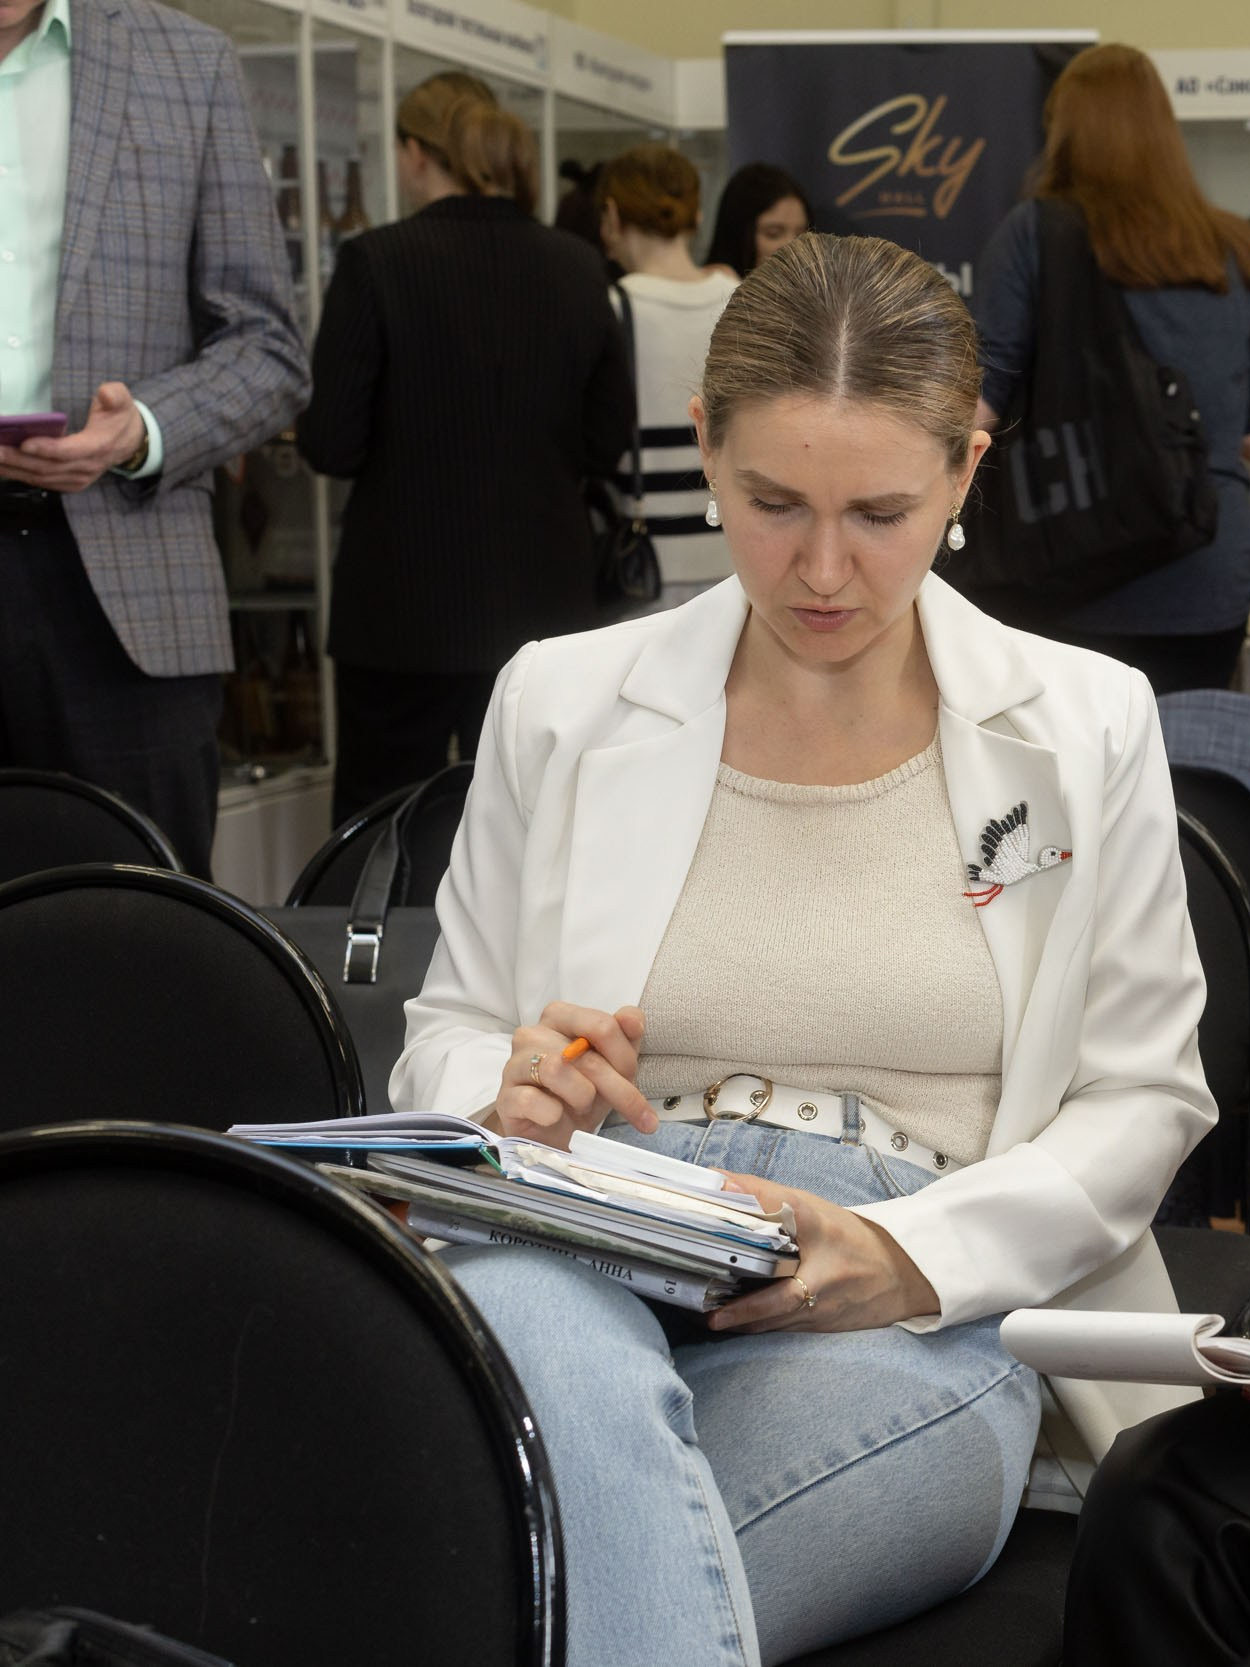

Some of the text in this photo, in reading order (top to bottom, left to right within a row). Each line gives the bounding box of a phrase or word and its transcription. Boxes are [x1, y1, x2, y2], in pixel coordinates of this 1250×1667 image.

[1176, 77, 1199, 95] АО
[829, 93, 986, 220] Sky
[489, 1229, 633, 1281] КОРО АННА
